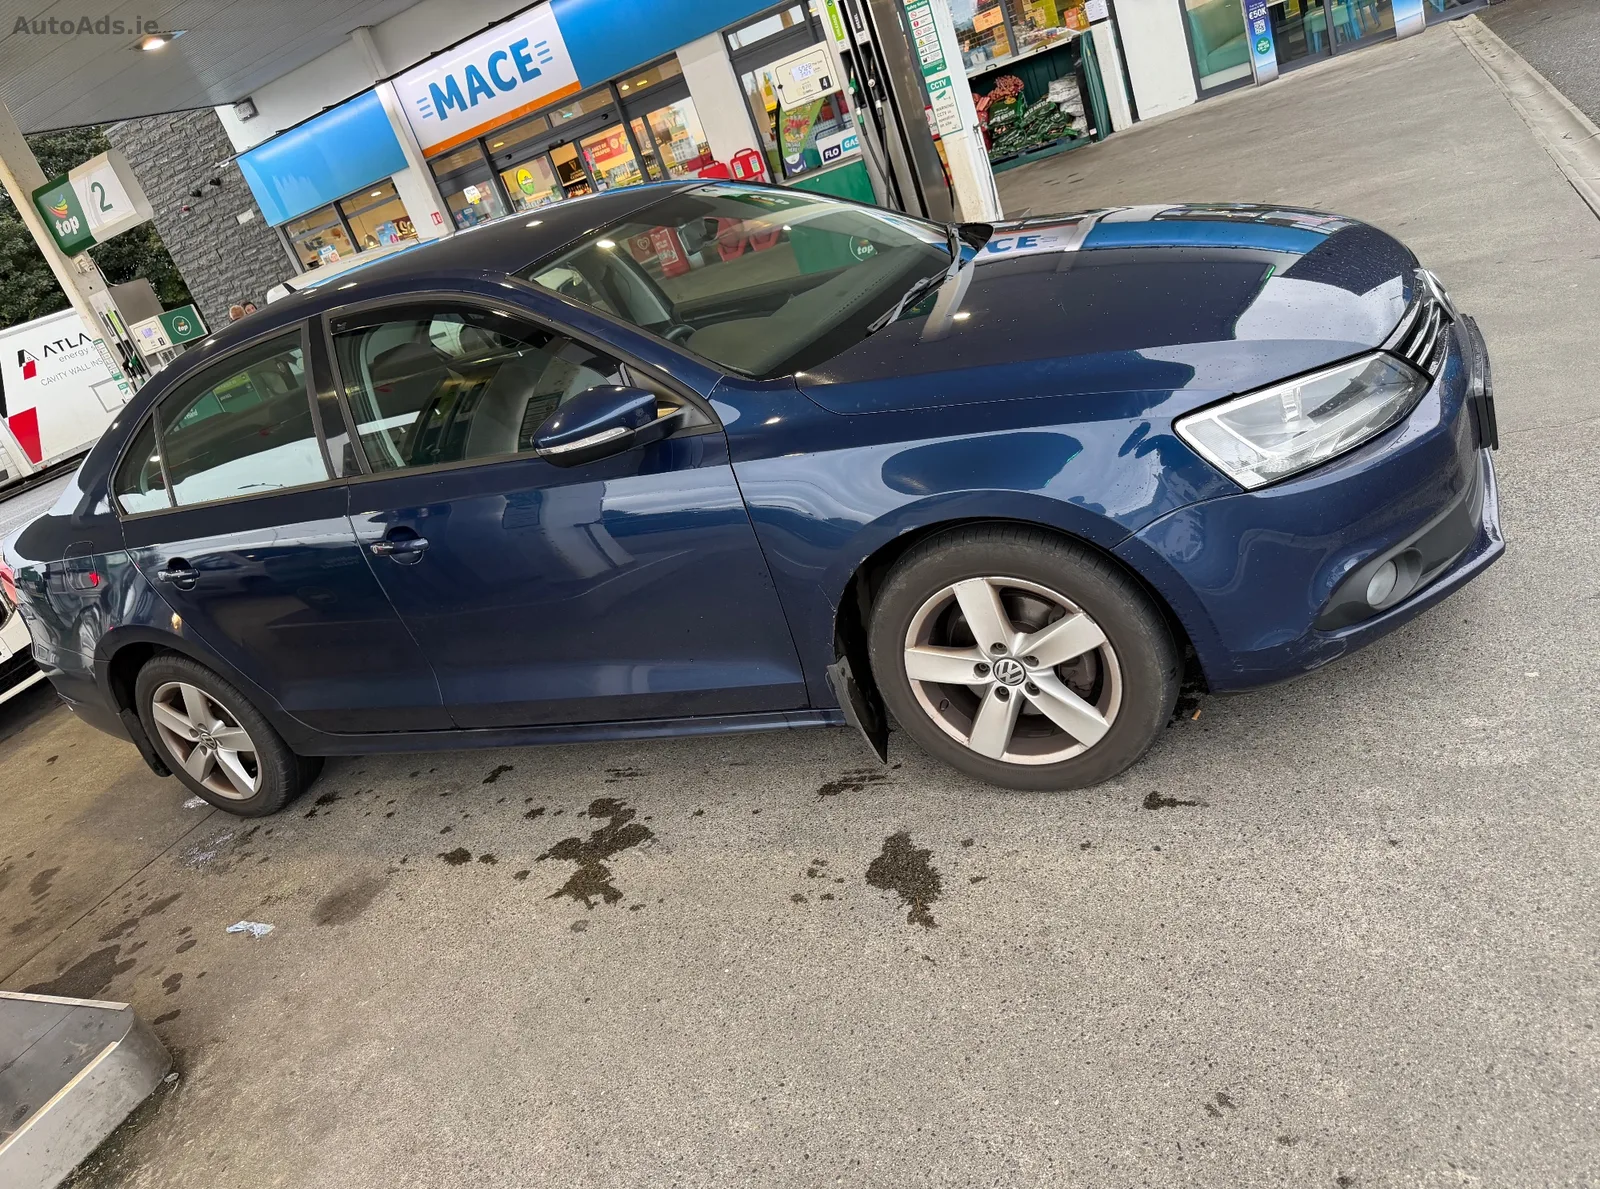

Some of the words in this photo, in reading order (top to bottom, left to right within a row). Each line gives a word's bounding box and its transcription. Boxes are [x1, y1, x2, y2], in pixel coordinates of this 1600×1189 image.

[428, 37, 542, 121] MACE
[822, 78, 828, 88] 4
[930, 79, 946, 90] CCTV
[824, 148, 839, 159] FLO
[91, 182, 113, 213] 2
[55, 215, 80, 237] top
[857, 244, 874, 255] top
[59, 348, 88, 363] energy
[40, 372, 68, 386] CAVITY
[69, 363, 91, 376] WALL
